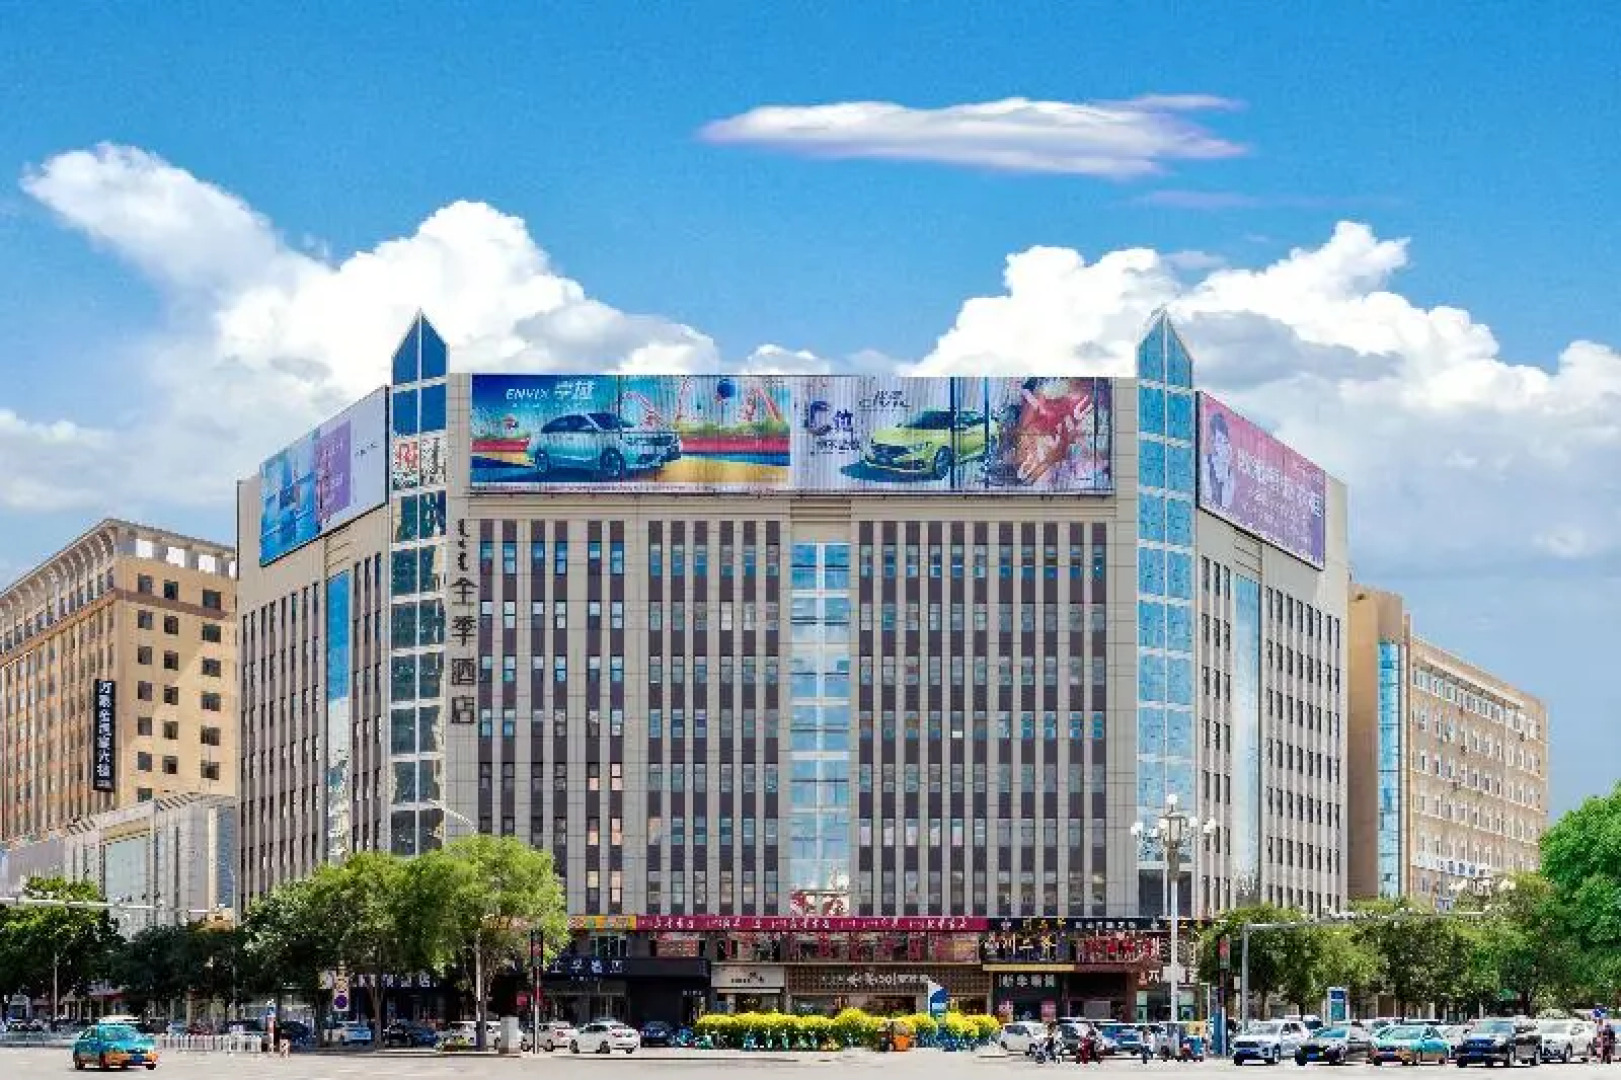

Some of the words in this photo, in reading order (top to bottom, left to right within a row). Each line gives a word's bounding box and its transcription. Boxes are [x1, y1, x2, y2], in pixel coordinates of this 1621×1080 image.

[506, 388, 550, 400] ENVIX
[450, 576, 479, 725] 全季酒店
